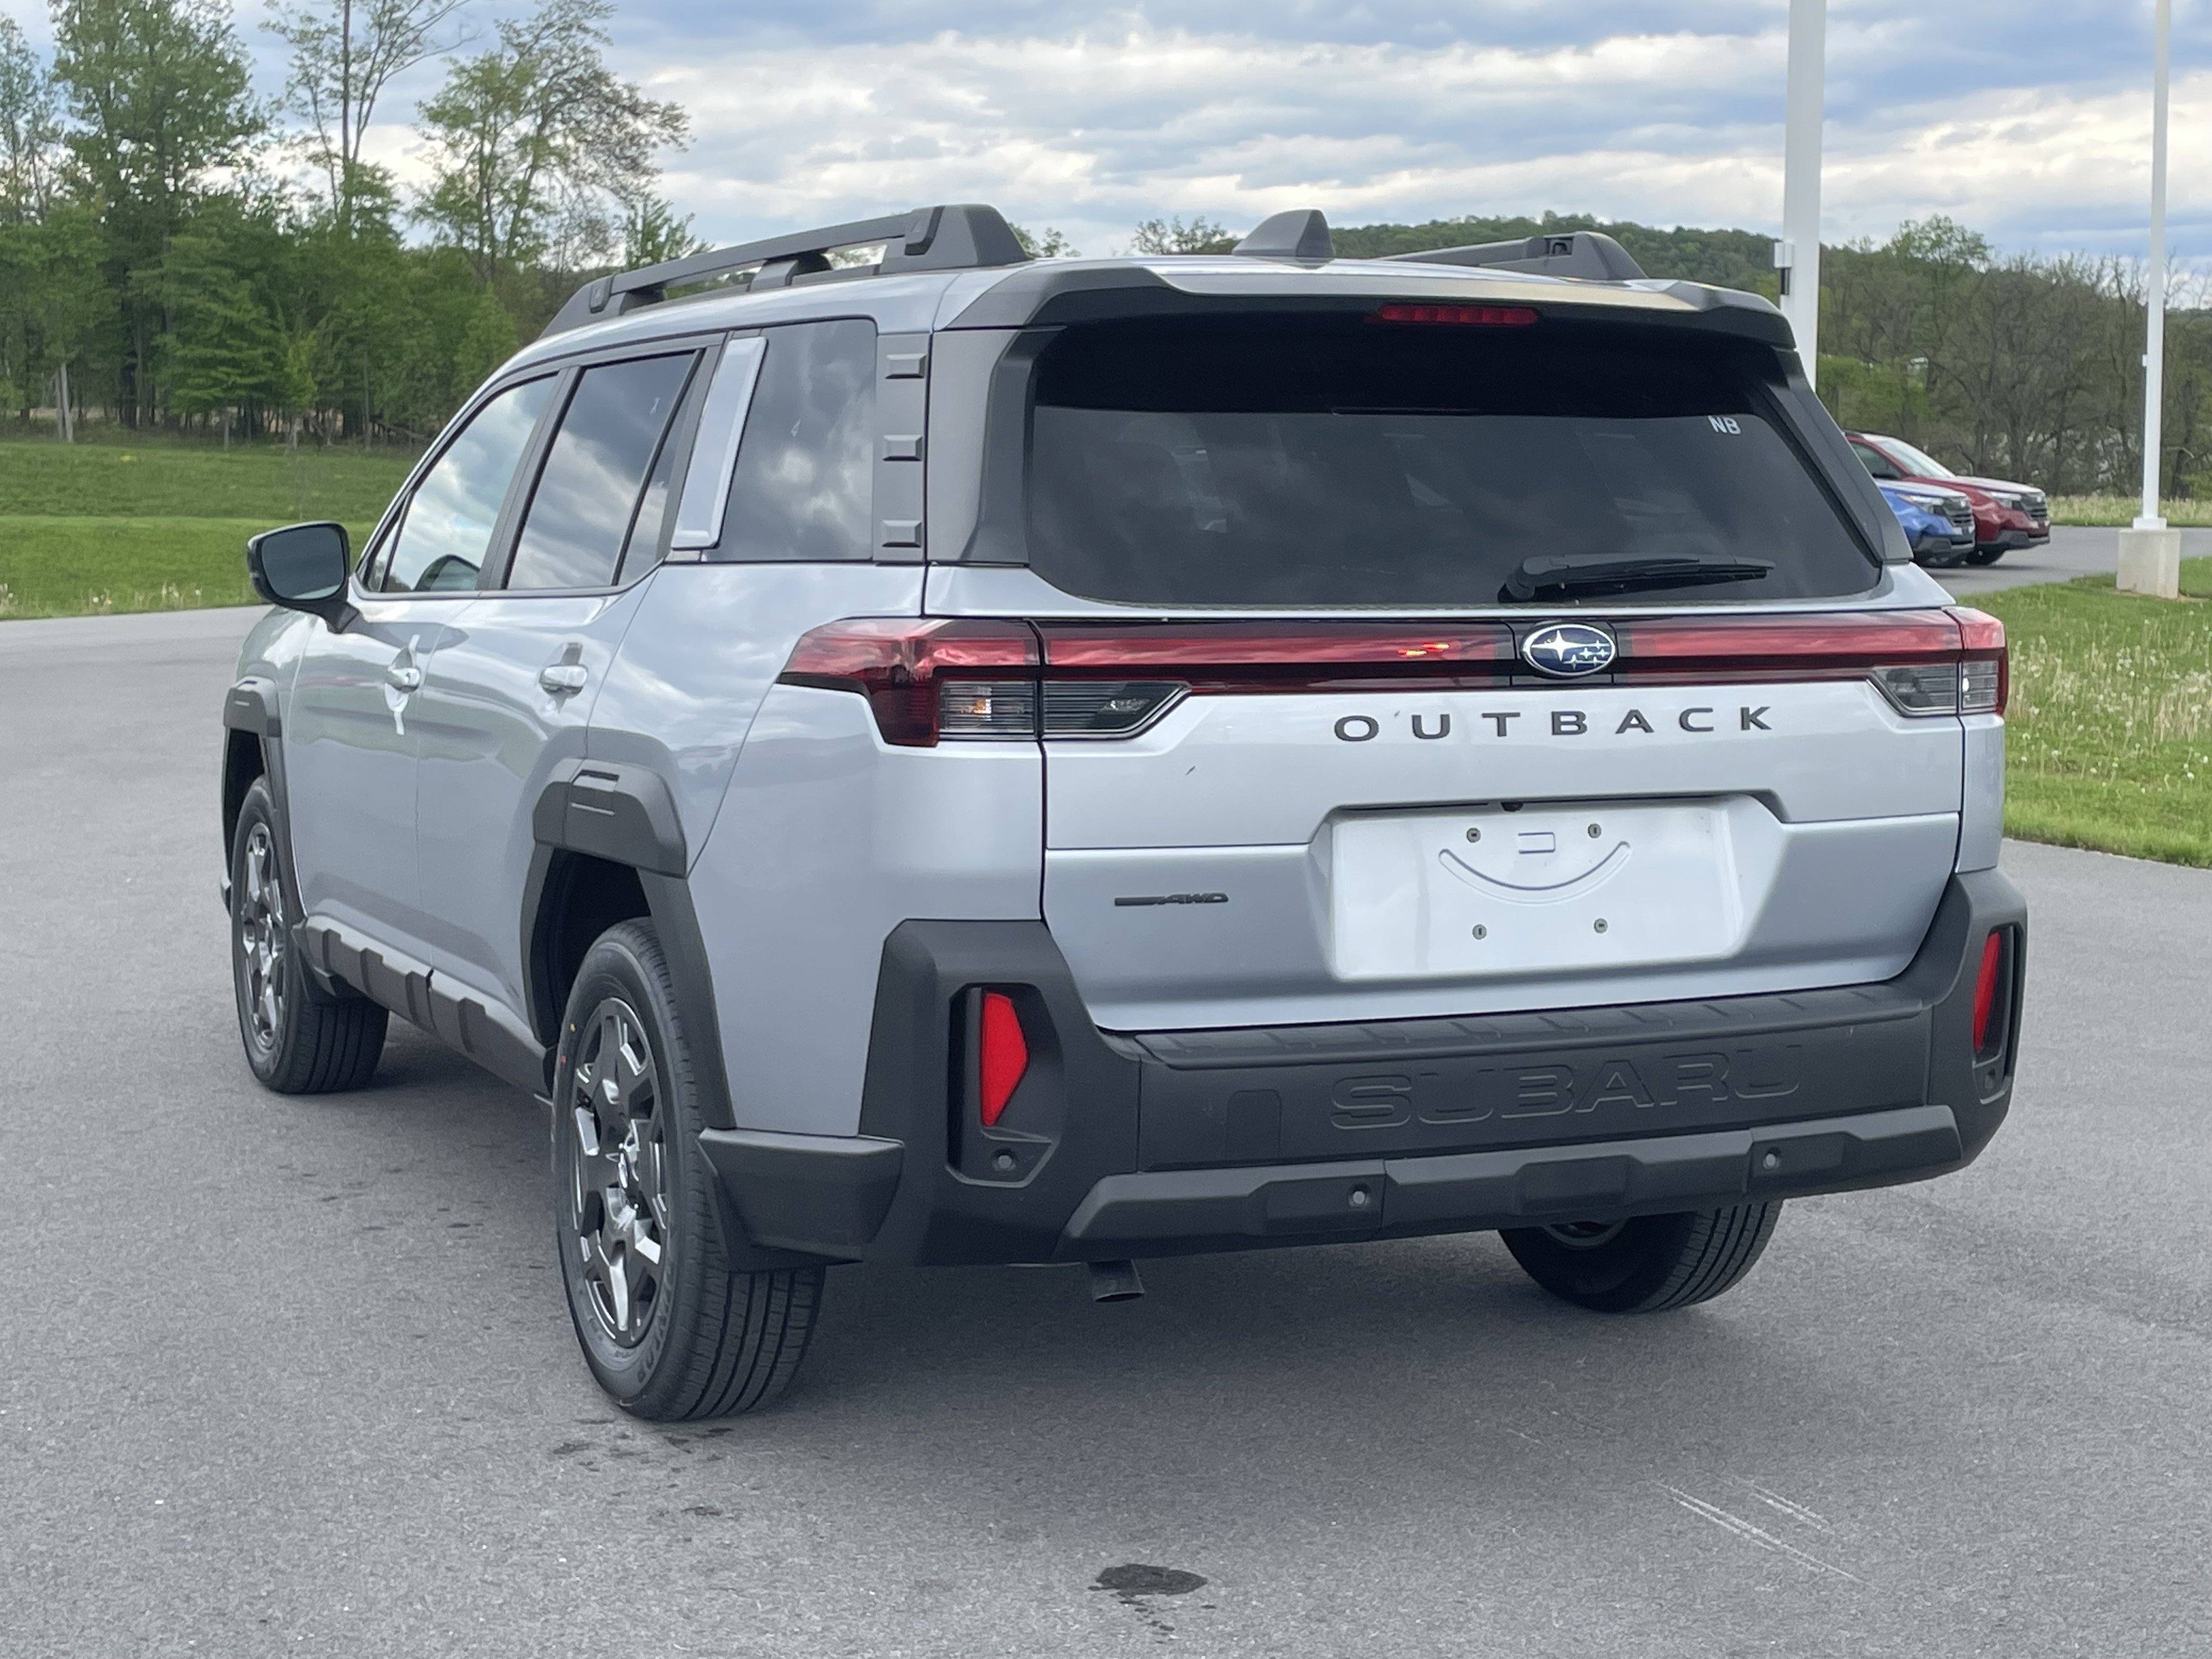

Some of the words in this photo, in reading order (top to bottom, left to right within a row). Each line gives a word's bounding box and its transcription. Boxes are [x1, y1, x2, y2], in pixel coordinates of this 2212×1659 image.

[1708, 415, 1741, 435] NB
[1334, 706, 1773, 742] OUTBACK
[1330, 1044, 1802, 1130] SUBARU
